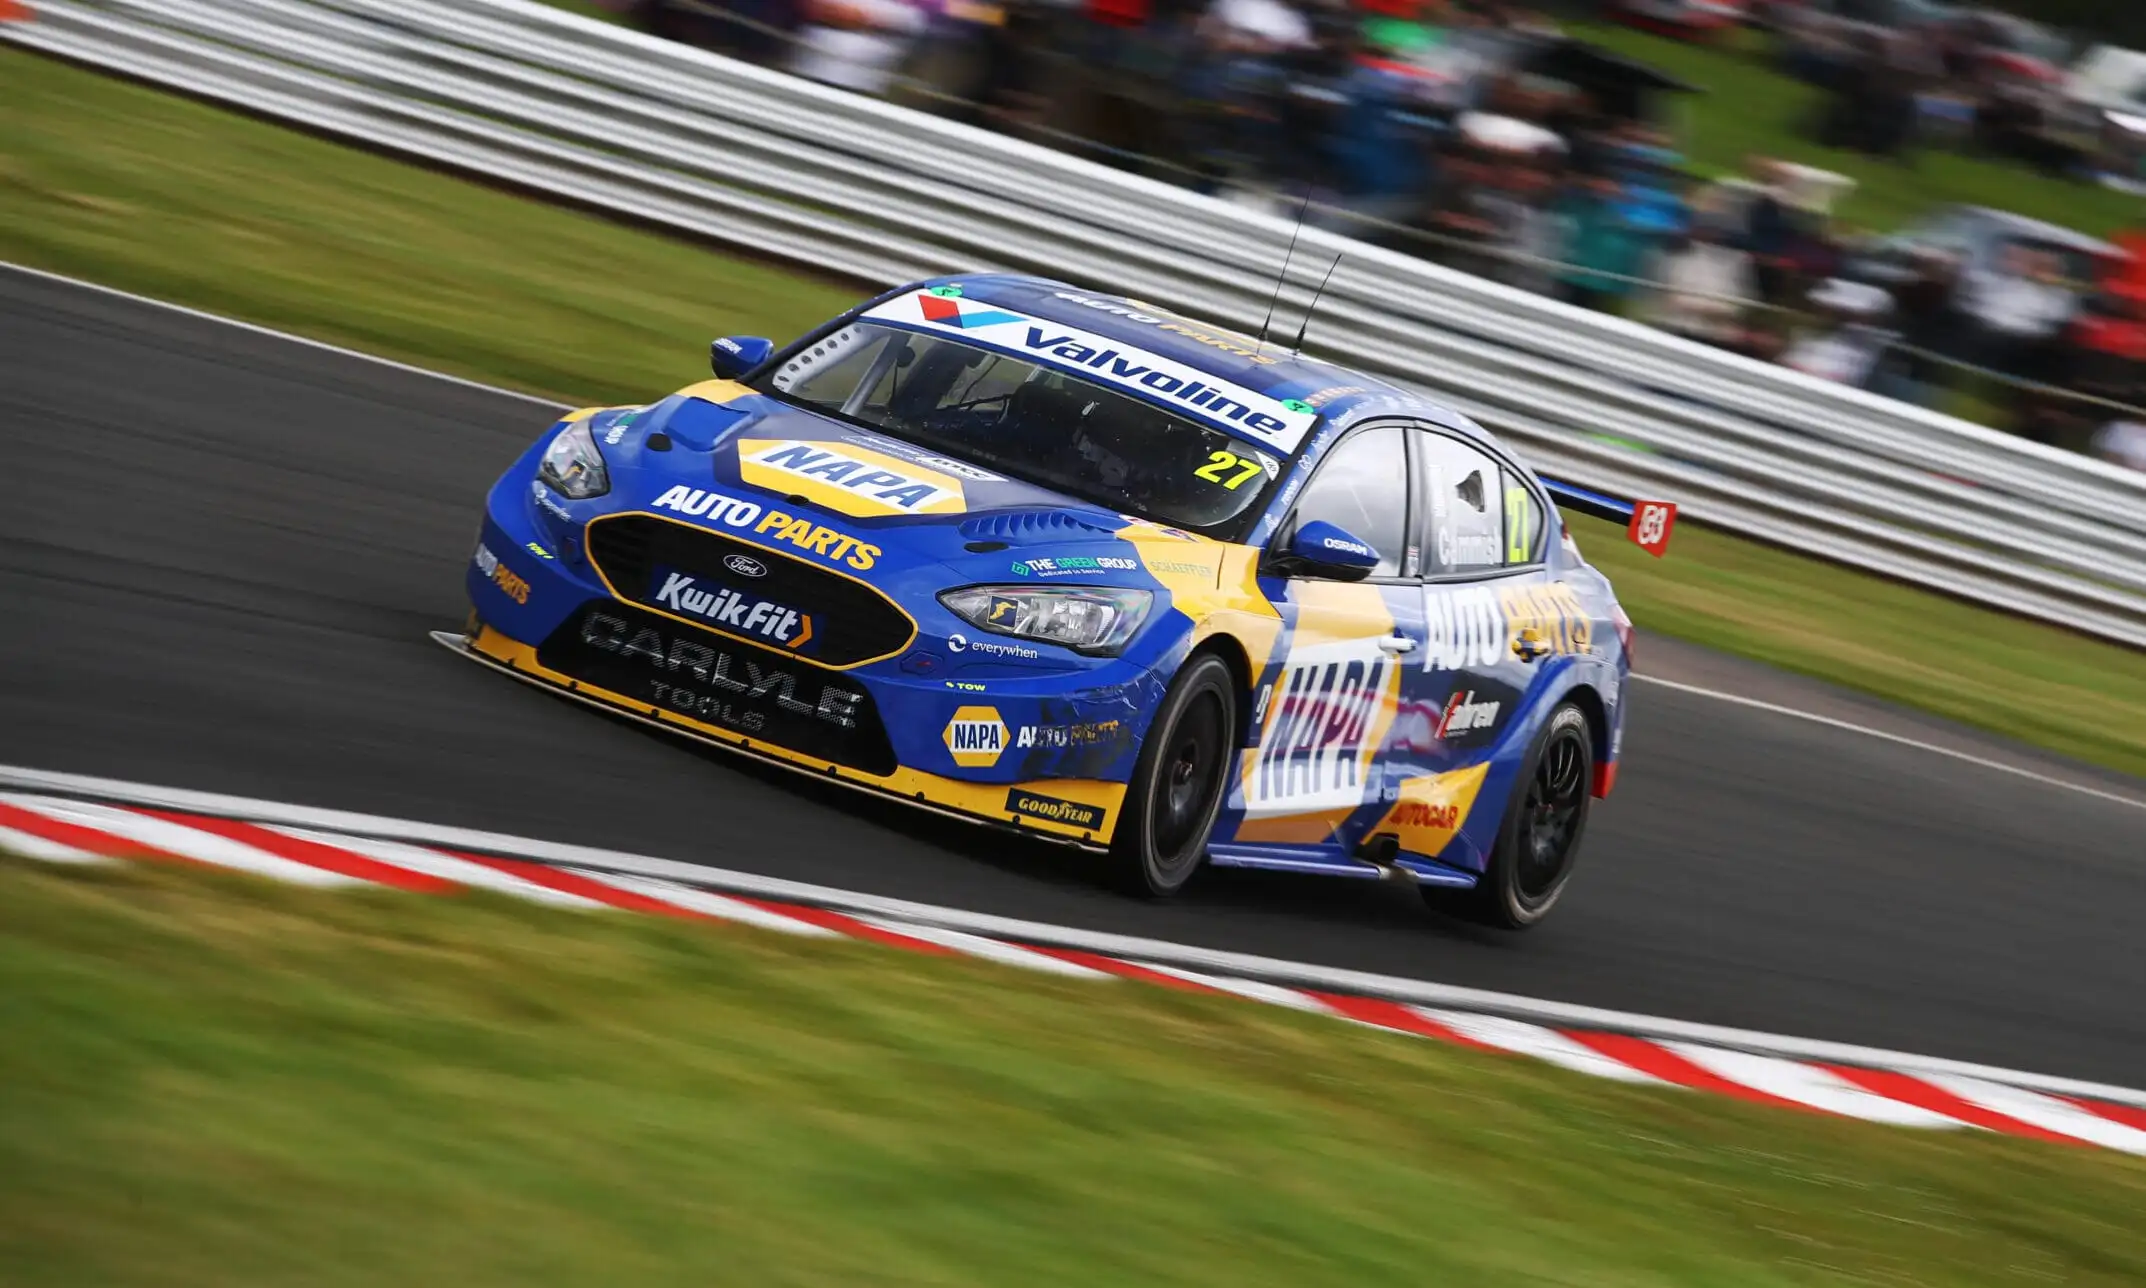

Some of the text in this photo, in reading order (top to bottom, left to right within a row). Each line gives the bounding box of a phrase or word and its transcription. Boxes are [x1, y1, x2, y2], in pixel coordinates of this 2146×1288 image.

[1025, 326, 1287, 434] Valvoline
[761, 446, 938, 507] NAPA
[1193, 451, 1263, 490] 27
[651, 485, 881, 570] AUTO PARTS
[1324, 538, 1367, 556] OSRAM
[730, 556, 759, 576] Ford
[1025, 557, 1136, 571] THE GREEN GROUP
[1423, 586, 1502, 672] AUTO
[972, 641, 1038, 659] everywhen
[582, 612, 863, 728] CARLYLE
[957, 683, 986, 691] TOW
[651, 679, 765, 731] TOOLS
[954, 723, 999, 750] NAPA
[1260, 656, 1384, 800] NAPA
[1018, 798, 1093, 824] GOODYEAR
